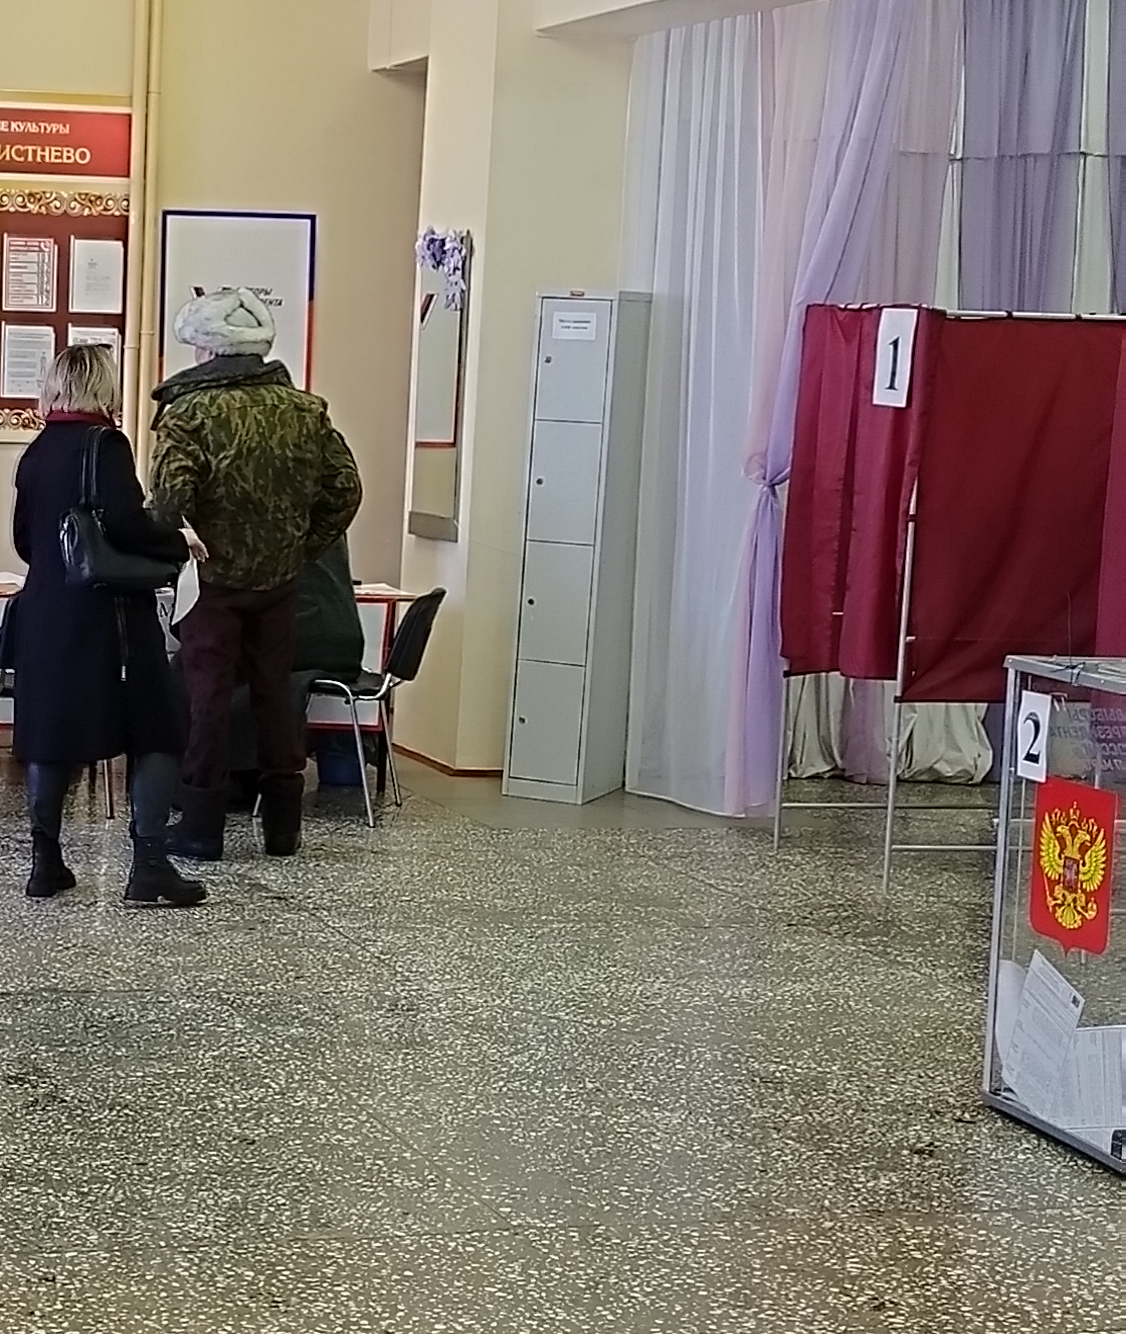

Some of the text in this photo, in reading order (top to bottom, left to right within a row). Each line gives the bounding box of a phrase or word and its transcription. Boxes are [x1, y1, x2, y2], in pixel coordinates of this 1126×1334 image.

[10, 120, 71, 135] КУЛЬТУРЫ
[884, 335, 901, 391] 1
[1022, 711, 1042, 765] 2
